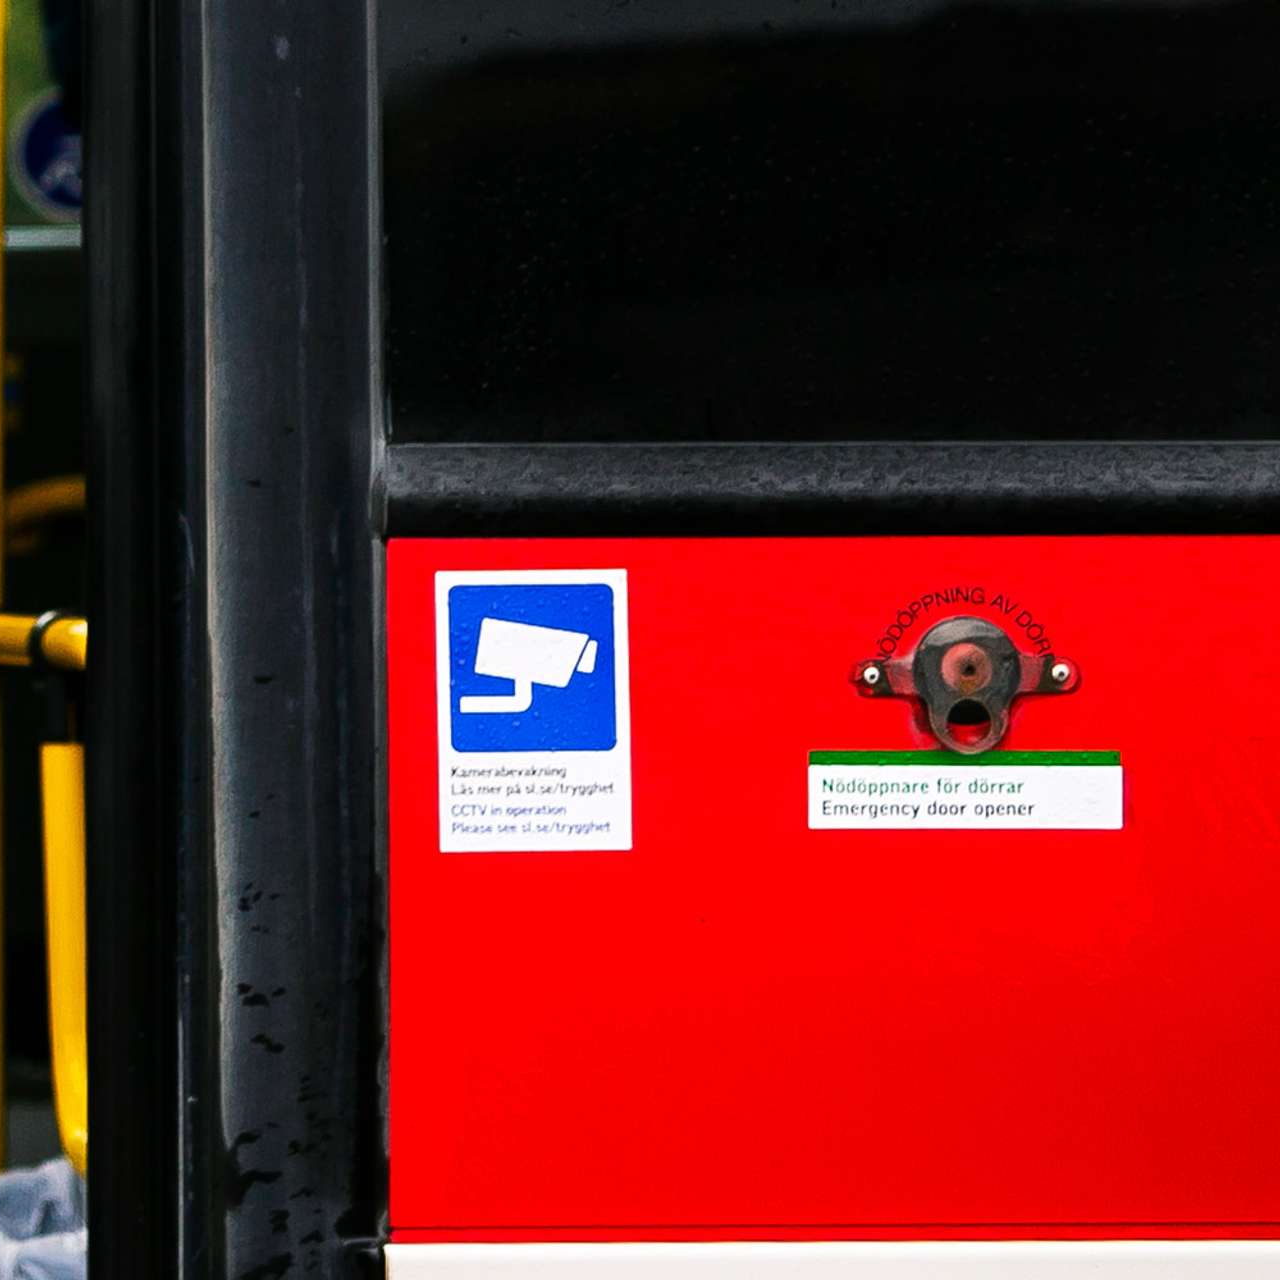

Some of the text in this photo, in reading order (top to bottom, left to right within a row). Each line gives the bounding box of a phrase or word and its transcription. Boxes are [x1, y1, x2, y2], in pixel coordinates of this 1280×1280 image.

[991, 594, 1018, 615] AV
[451, 766, 567, 779] Kamerabevakning
[477, 786, 502, 795] mer
[506, 783, 522, 797] på
[822, 777, 1025, 795] Nödöppnare för dörrar
[451, 804, 567, 818] CCTV in operation
[822, 800, 1036, 819] Emergency door opener
[452, 822, 493, 834] Please
[497, 824, 517, 833] see
